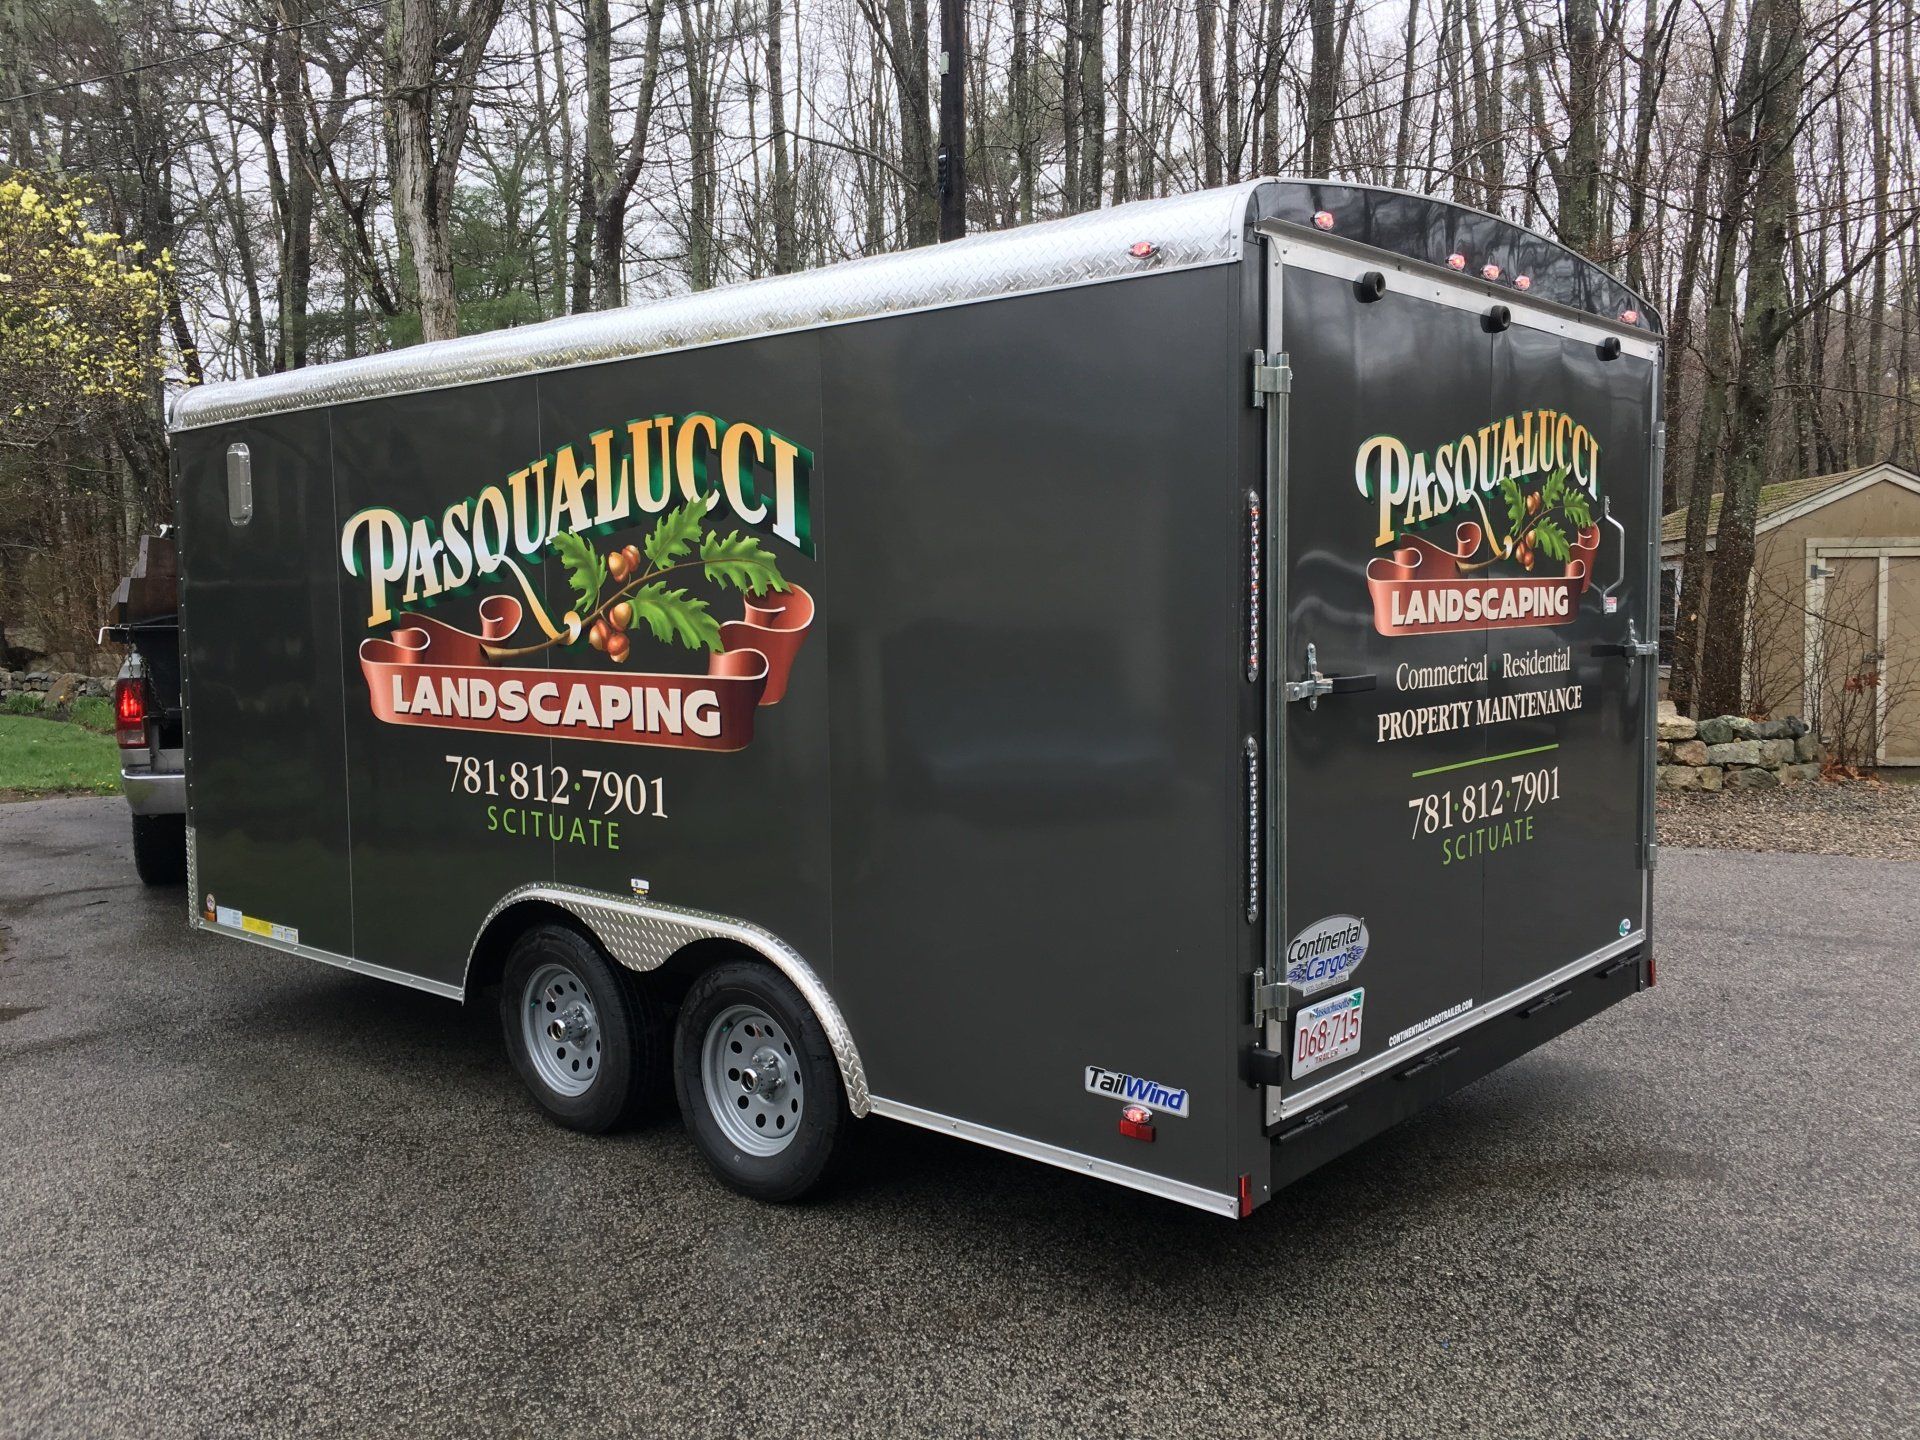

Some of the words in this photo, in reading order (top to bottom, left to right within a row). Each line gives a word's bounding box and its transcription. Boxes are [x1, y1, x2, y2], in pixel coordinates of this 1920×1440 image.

[1355, 408, 1602, 548] PASQUALUCCI
[341, 411, 815, 628] PASQUALUCCI
[1391, 585, 1569, 626] LANDSCAPING
[1396, 654, 1488, 691] Commerical
[1502, 647, 1571, 678] Residential
[391, 674, 721, 737] LANDSCAPING
[1377, 700, 1473, 743] PROPERTY
[1476, 685, 1582, 726] MAINTENANCE
[487, 805, 620, 850] SCITUATE
[1443, 816, 1534, 865] SCITUATE
[1287, 917, 1364, 964] Continental
[1306, 952, 1348, 981] Cargo
[1089, 1066, 1186, 1110] TailWind
